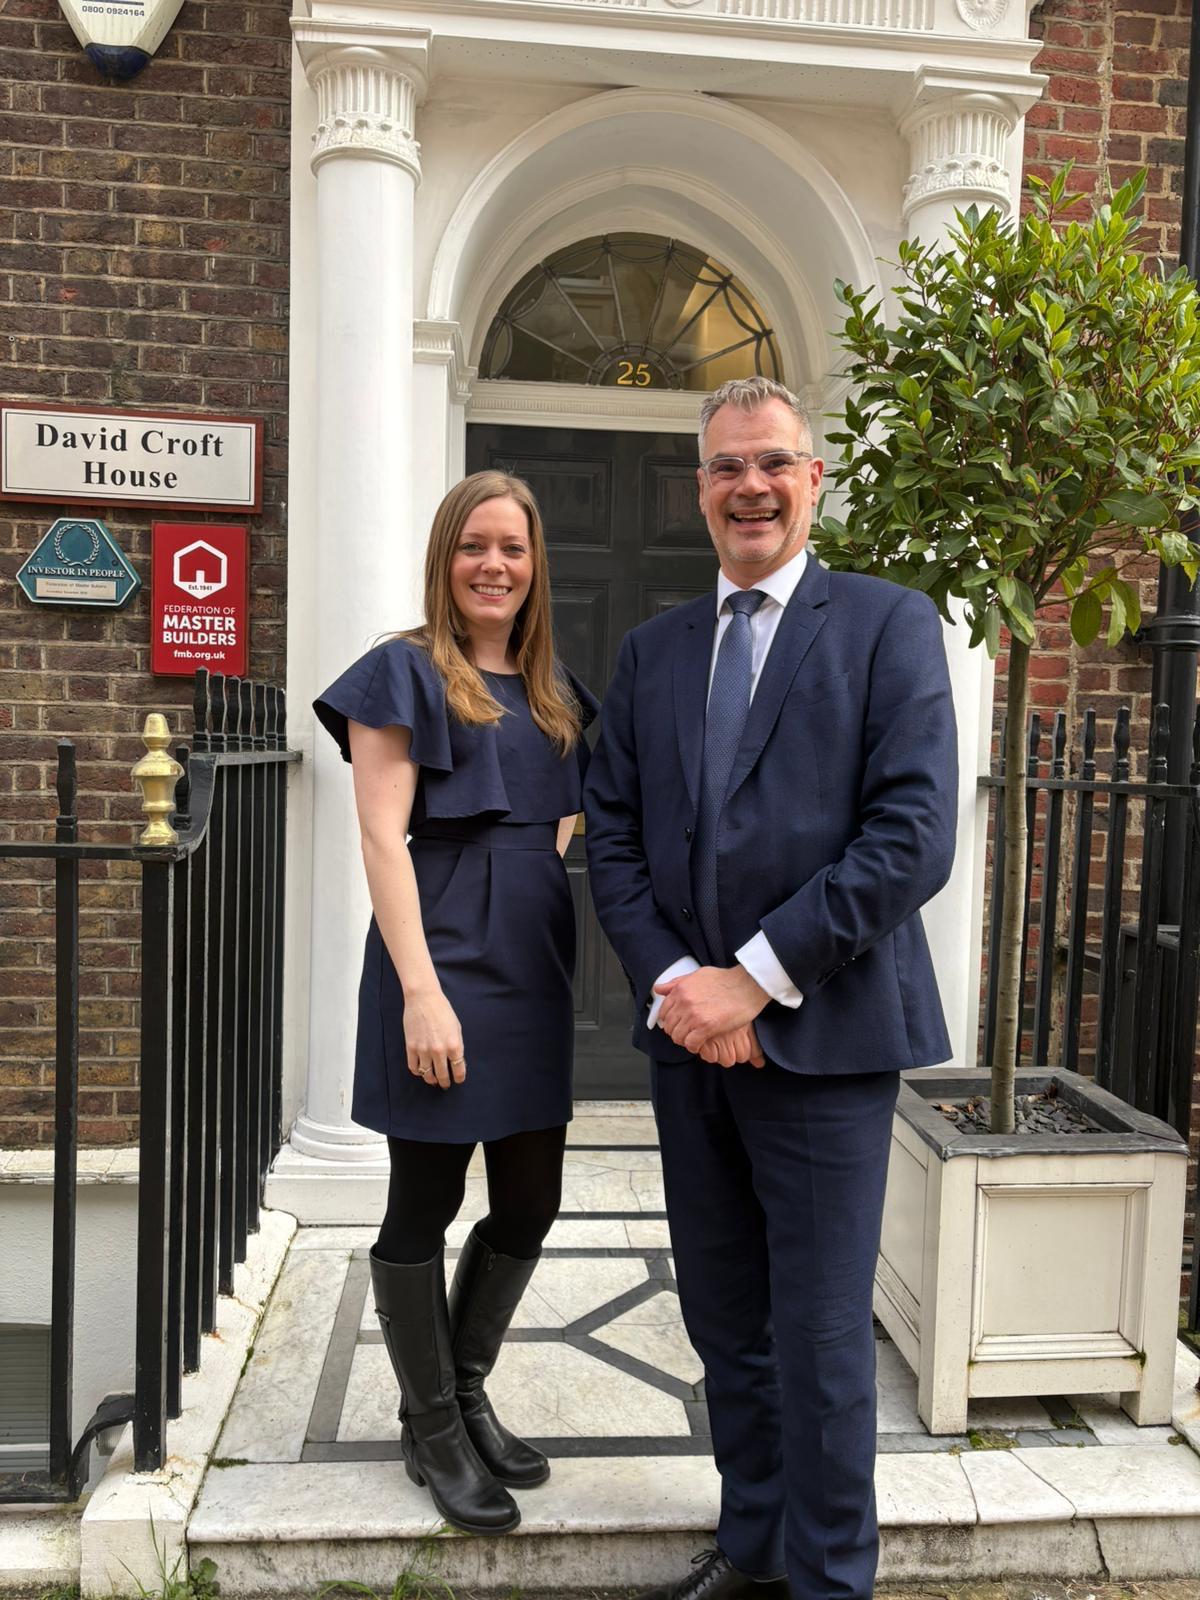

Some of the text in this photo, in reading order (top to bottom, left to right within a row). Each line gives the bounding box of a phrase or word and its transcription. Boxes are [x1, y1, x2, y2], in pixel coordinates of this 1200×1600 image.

[82, 5, 145, 16] 0800 0924164
[617, 361, 651, 386] 25
[35, 423, 224, 457] David Croft
[82, 460, 178, 488] House
[27, 566, 125, 577] INVESTOR IN PEOPLE
[163, 604, 236, 615] FEDERATION OF
[163, 614, 236, 631] MASTER
[162, 631, 237, 646] BUILDERS
[173, 649, 226, 661] fmb.org.uk
